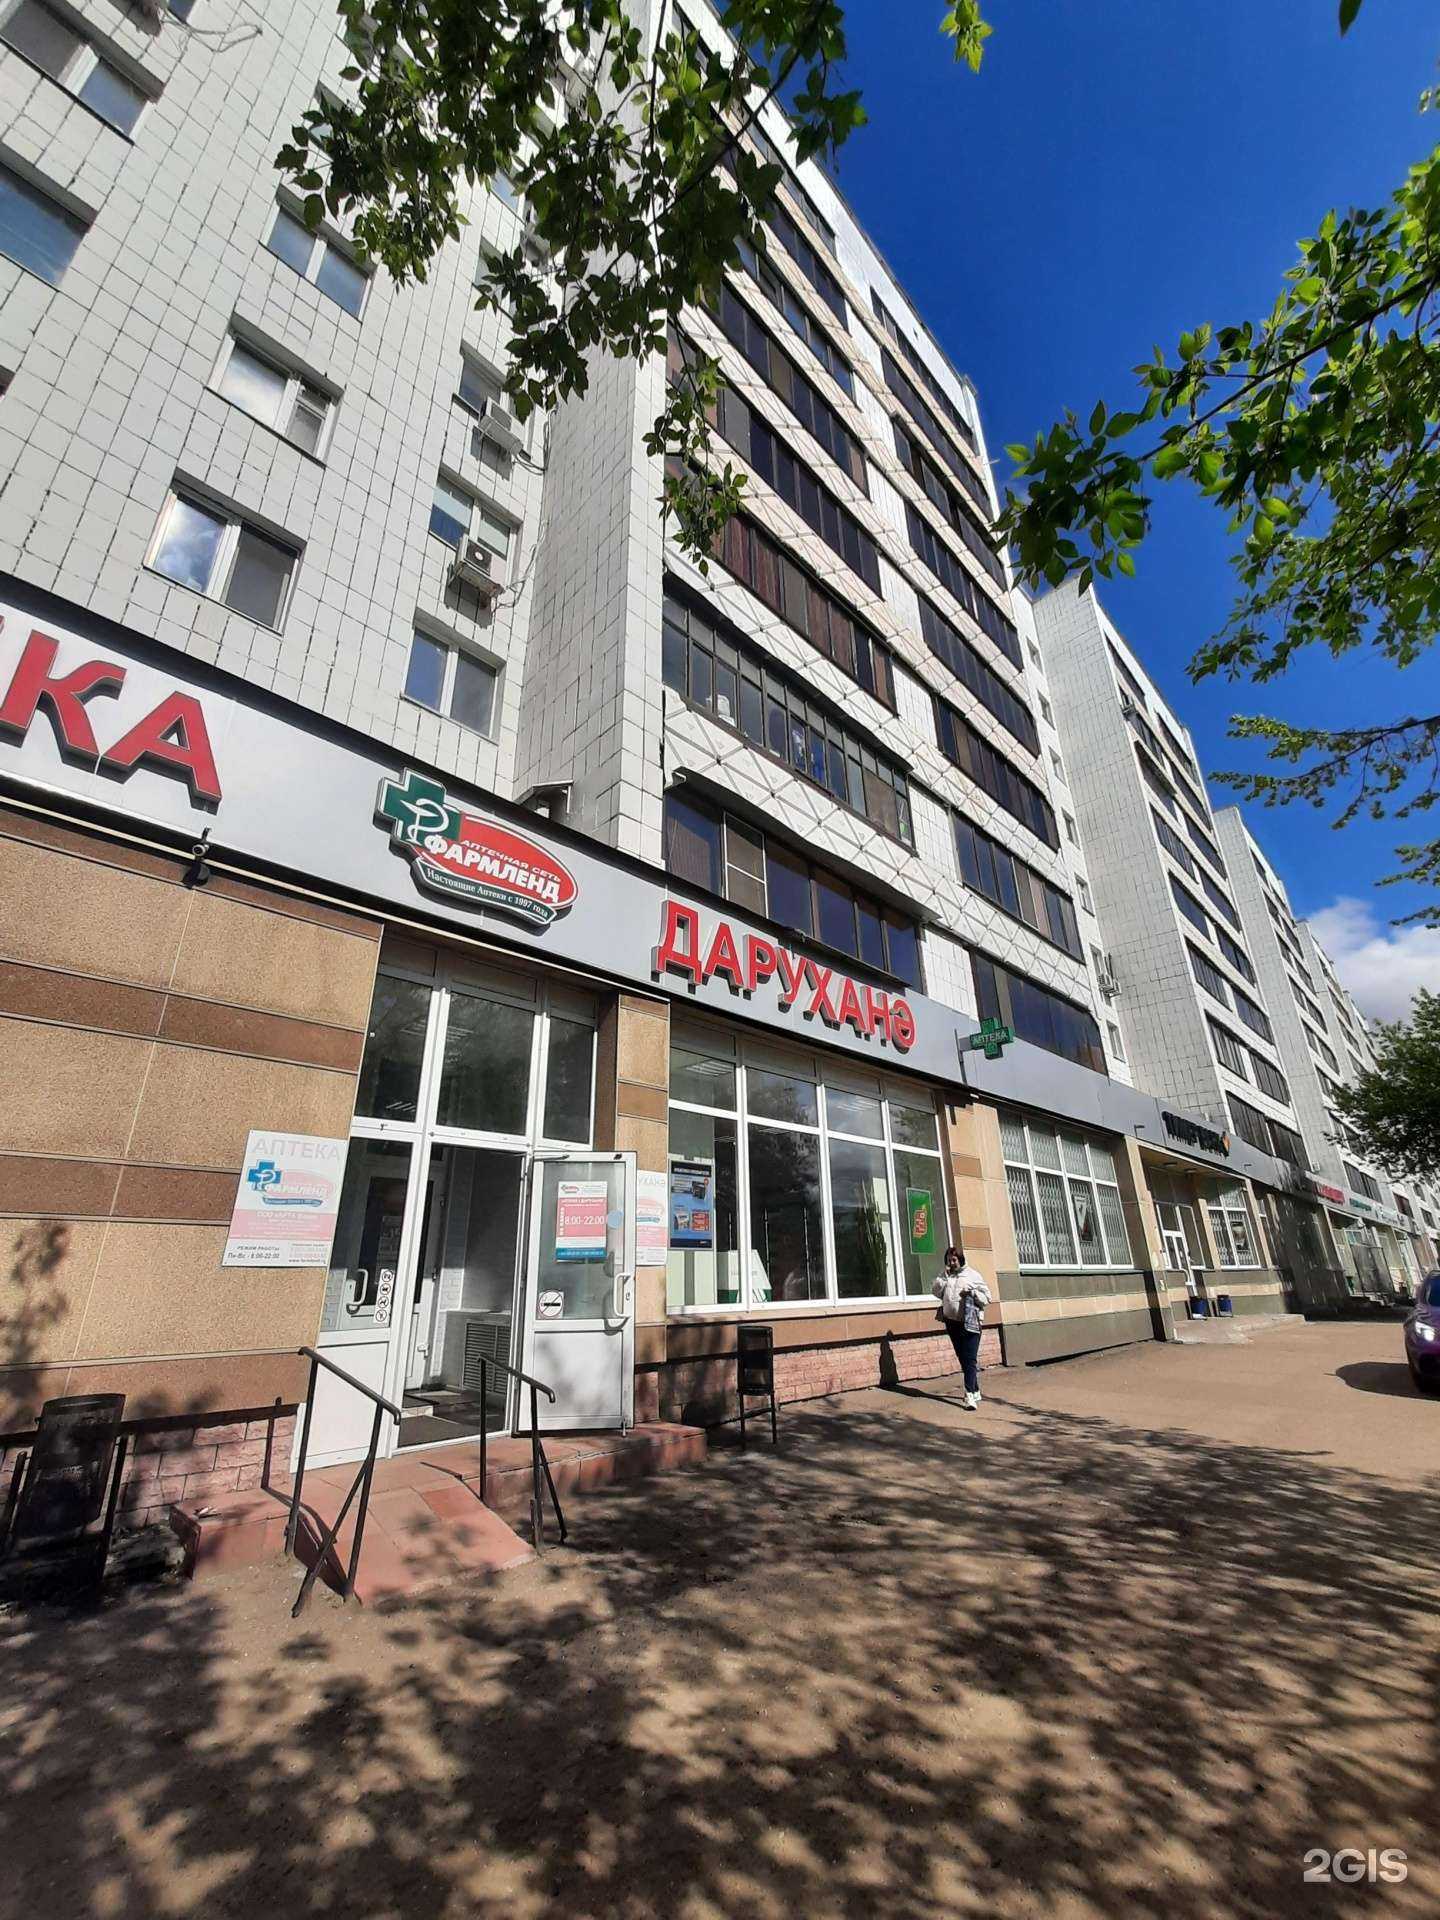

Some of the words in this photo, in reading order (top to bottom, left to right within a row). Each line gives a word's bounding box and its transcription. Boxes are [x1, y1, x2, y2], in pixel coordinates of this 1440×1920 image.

[0, 615, 222, 812] КА
[424, 834, 560, 903] ФАРМЛЕНД
[460, 839, 528, 868] АПТЕЧНАЯ
[532, 866, 561, 882] СЕТЬ
[427, 868, 475, 892] Настоящие
[477, 886, 506, 900] Аптеки
[514, 897, 532, 909] 1997
[533, 903, 548, 917] года
[652, 900, 917, 1053] ДАРУХАНӘ
[252, 1138, 340, 1160] АПТЕКА
